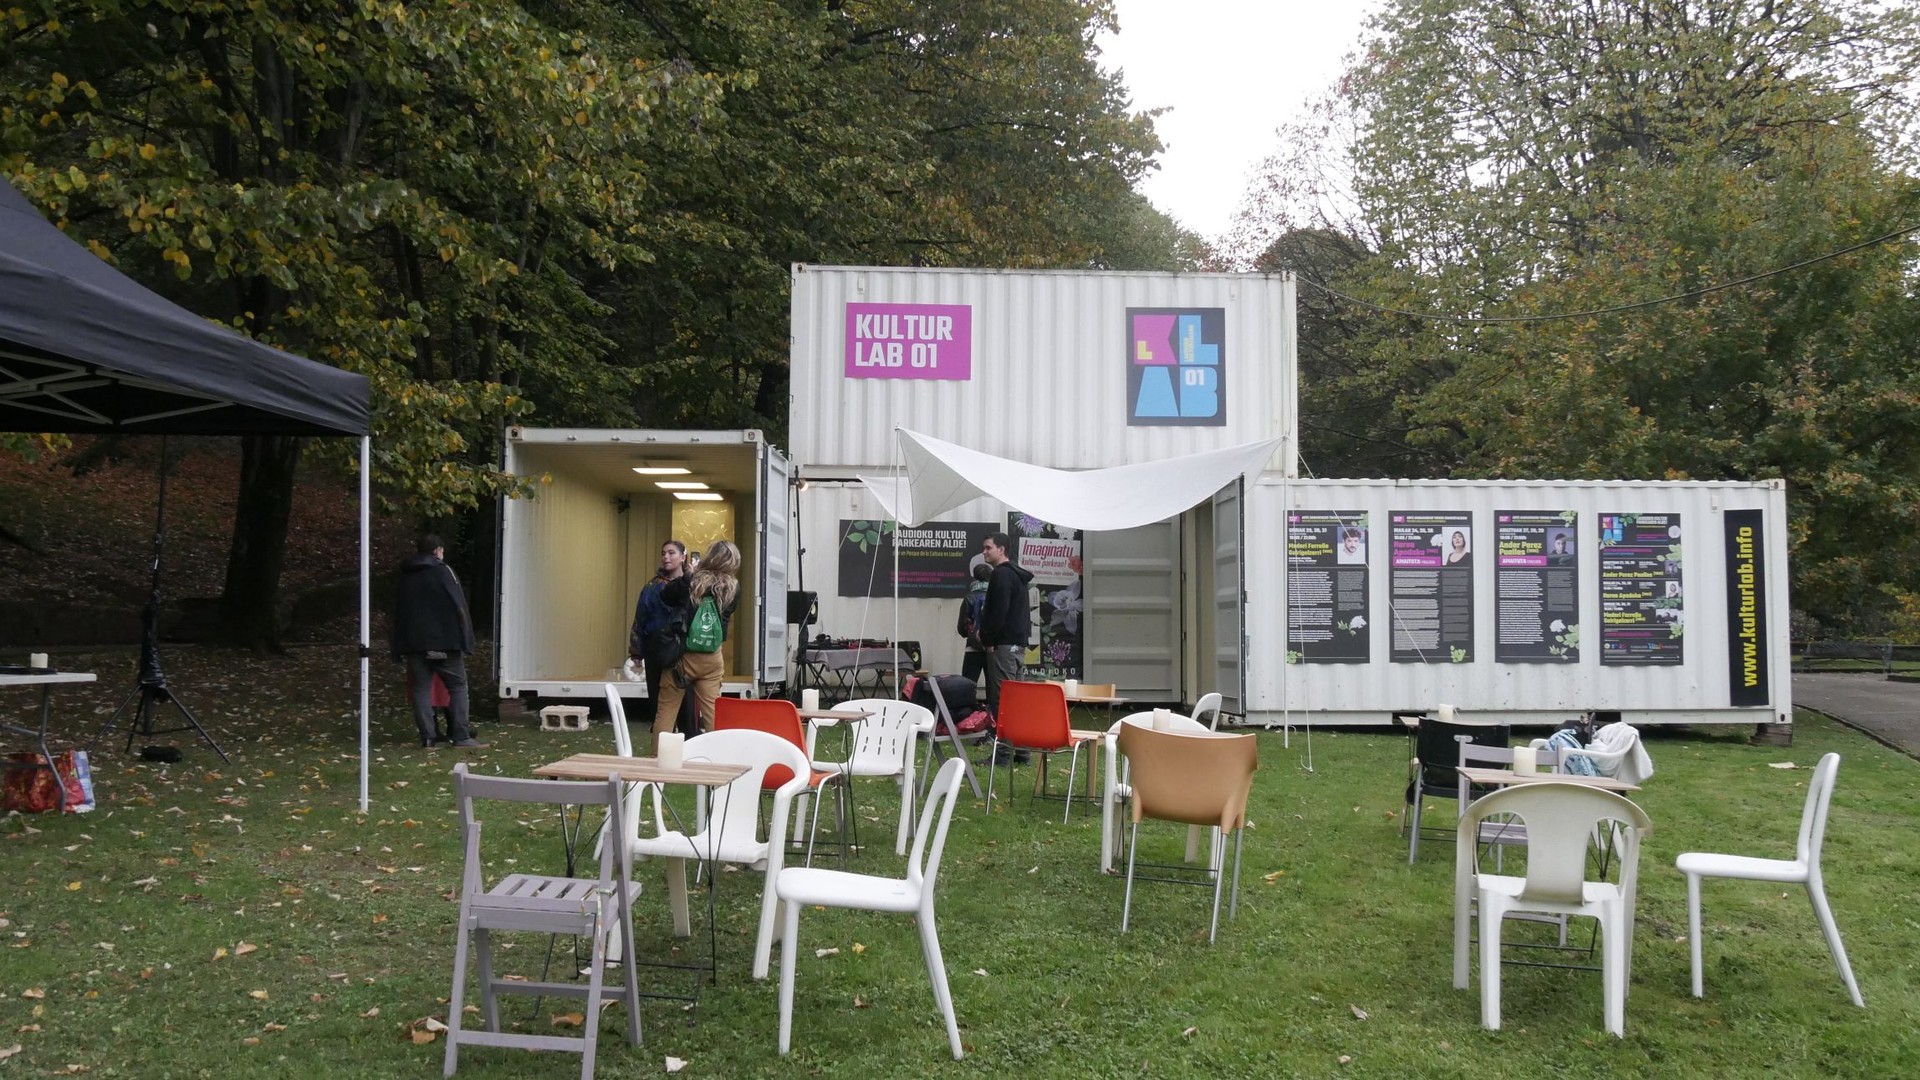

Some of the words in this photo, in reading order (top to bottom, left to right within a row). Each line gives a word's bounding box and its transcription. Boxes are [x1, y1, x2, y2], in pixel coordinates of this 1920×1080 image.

[856, 314, 953, 340] KULTUR
[855, 342, 903, 367] LAB
[911, 343, 937, 368] 01
[1185, 369, 1204, 386] 01
[892, 529, 934, 539] LAUDIOKO
[935, 530, 967, 540] KULTUR
[942, 540, 967, 549] ALDE!
[1022, 540, 1074, 560] Imaginatu
[1499, 541, 1520, 549] Ander
[1022, 558, 1040, 566] kultura
[1736, 526, 1757, 686] www.kulturlab.info
[1023, 667, 1076, 675] AUDIOKO
